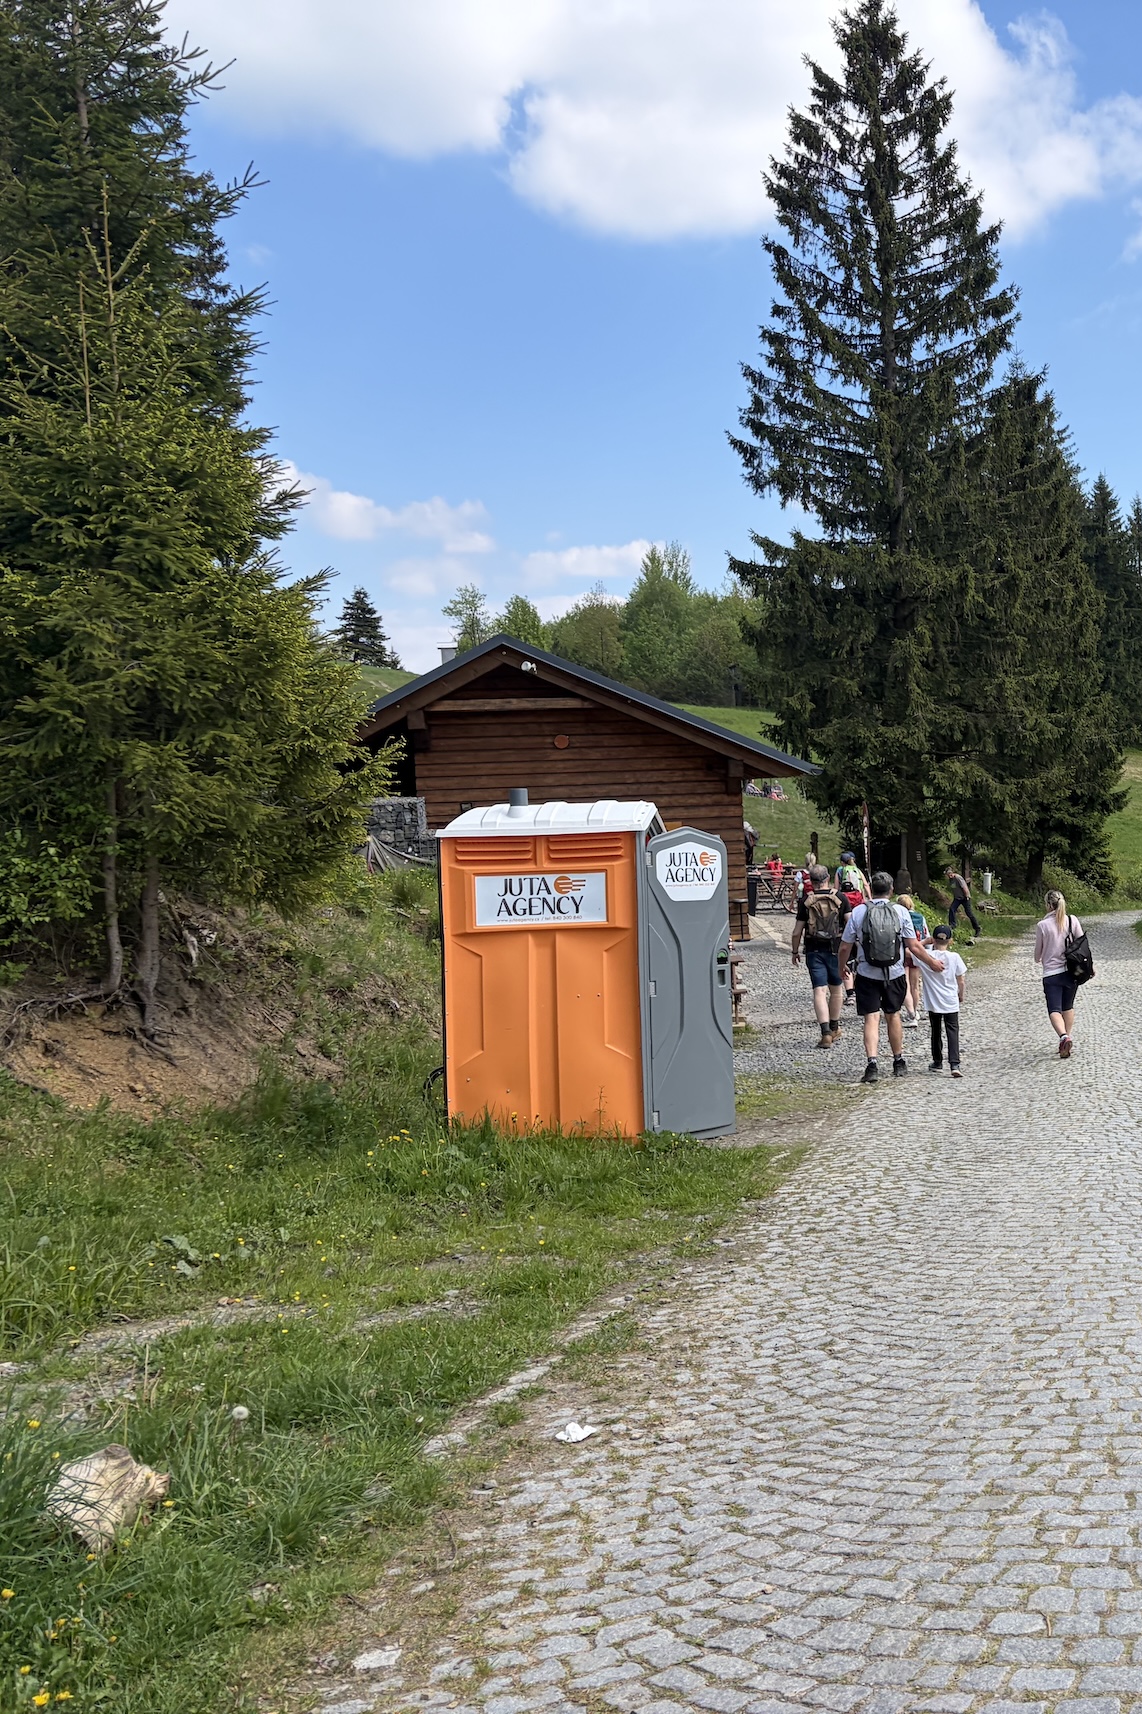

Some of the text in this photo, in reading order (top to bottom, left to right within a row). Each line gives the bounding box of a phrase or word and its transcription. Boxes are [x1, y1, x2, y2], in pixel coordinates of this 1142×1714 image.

[665, 852, 699, 867] JUTA
[665, 867, 716, 883] AGENCY
[497, 877, 552, 897] JUTA
[497, 896, 584, 917] AGENCY
